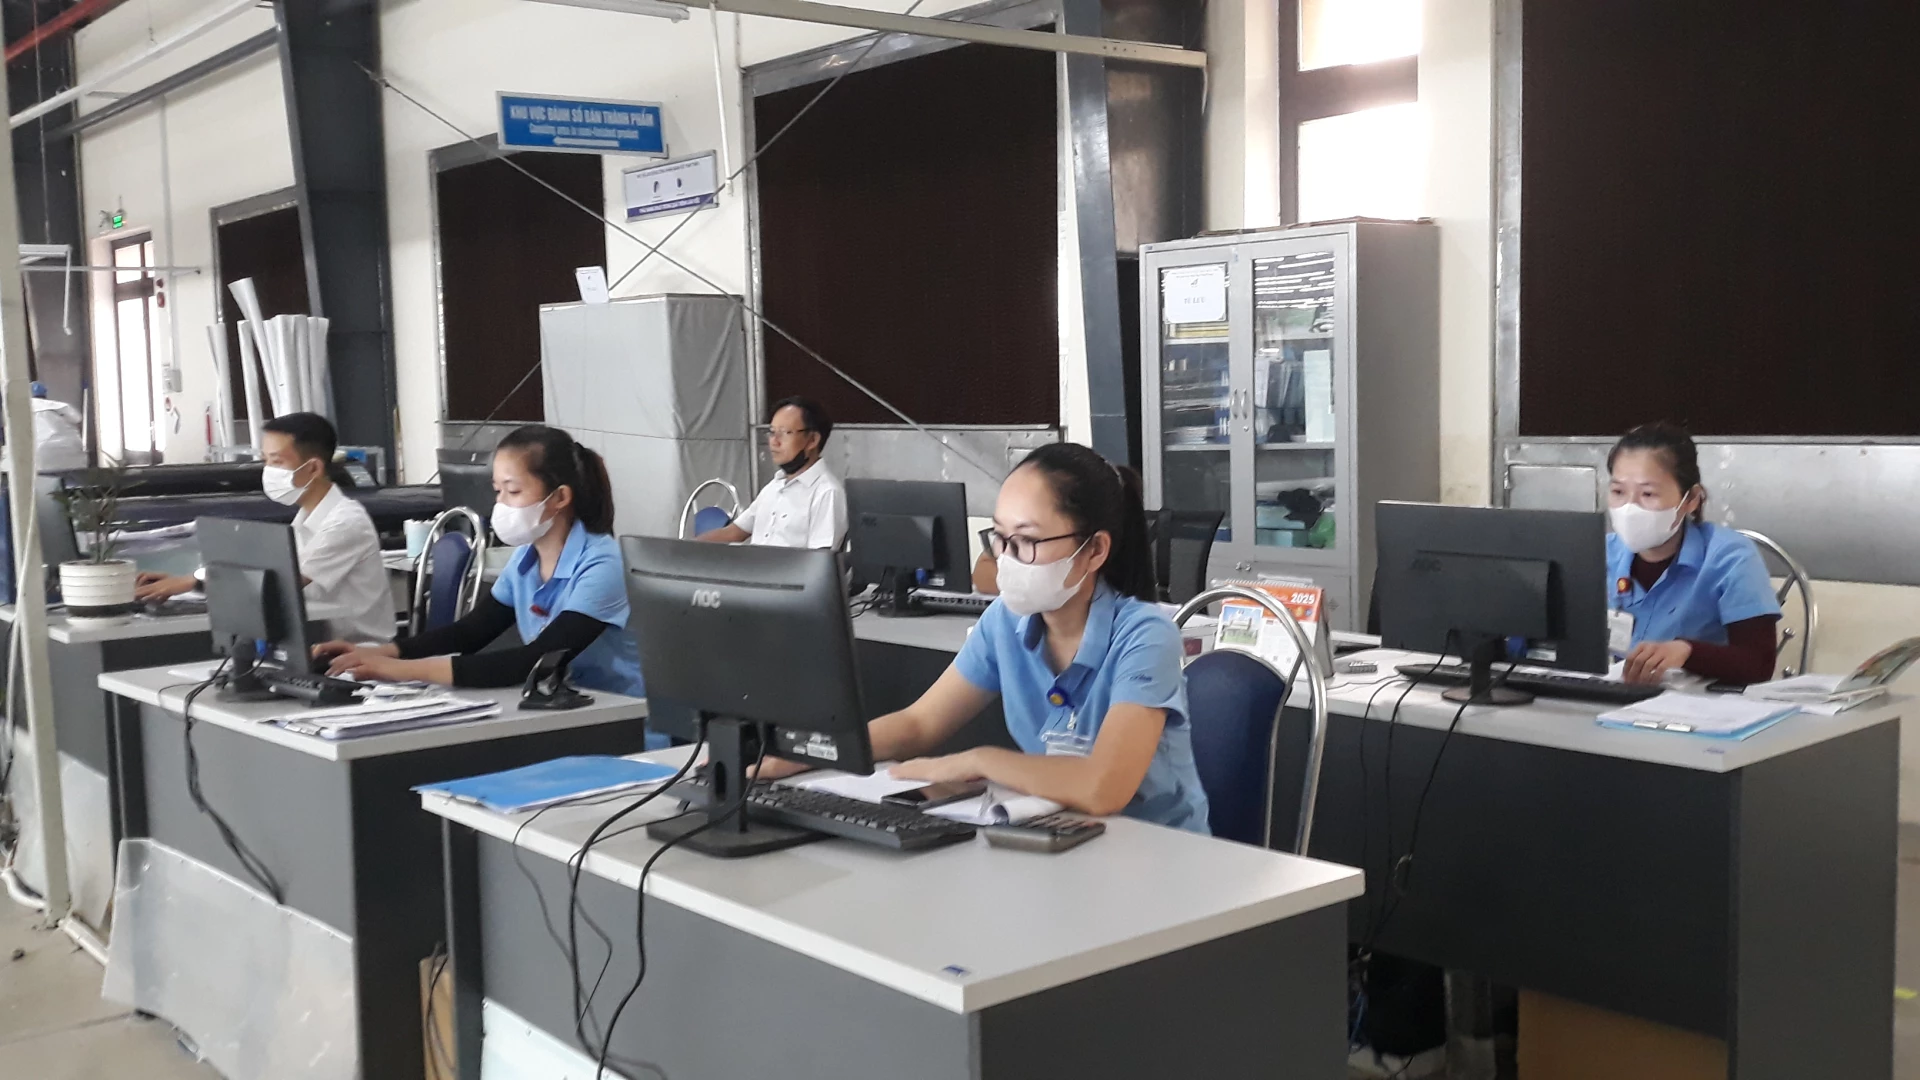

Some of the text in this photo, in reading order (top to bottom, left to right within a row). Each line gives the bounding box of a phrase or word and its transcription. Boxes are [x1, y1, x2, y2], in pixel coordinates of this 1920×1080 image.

[509, 105, 528, 119] KHU
[529, 106, 547, 123] VỰC
[571, 104, 583, 122] SỐ
[691, 590, 720, 608] AOC
[1290, 593, 1315, 605] 2025
